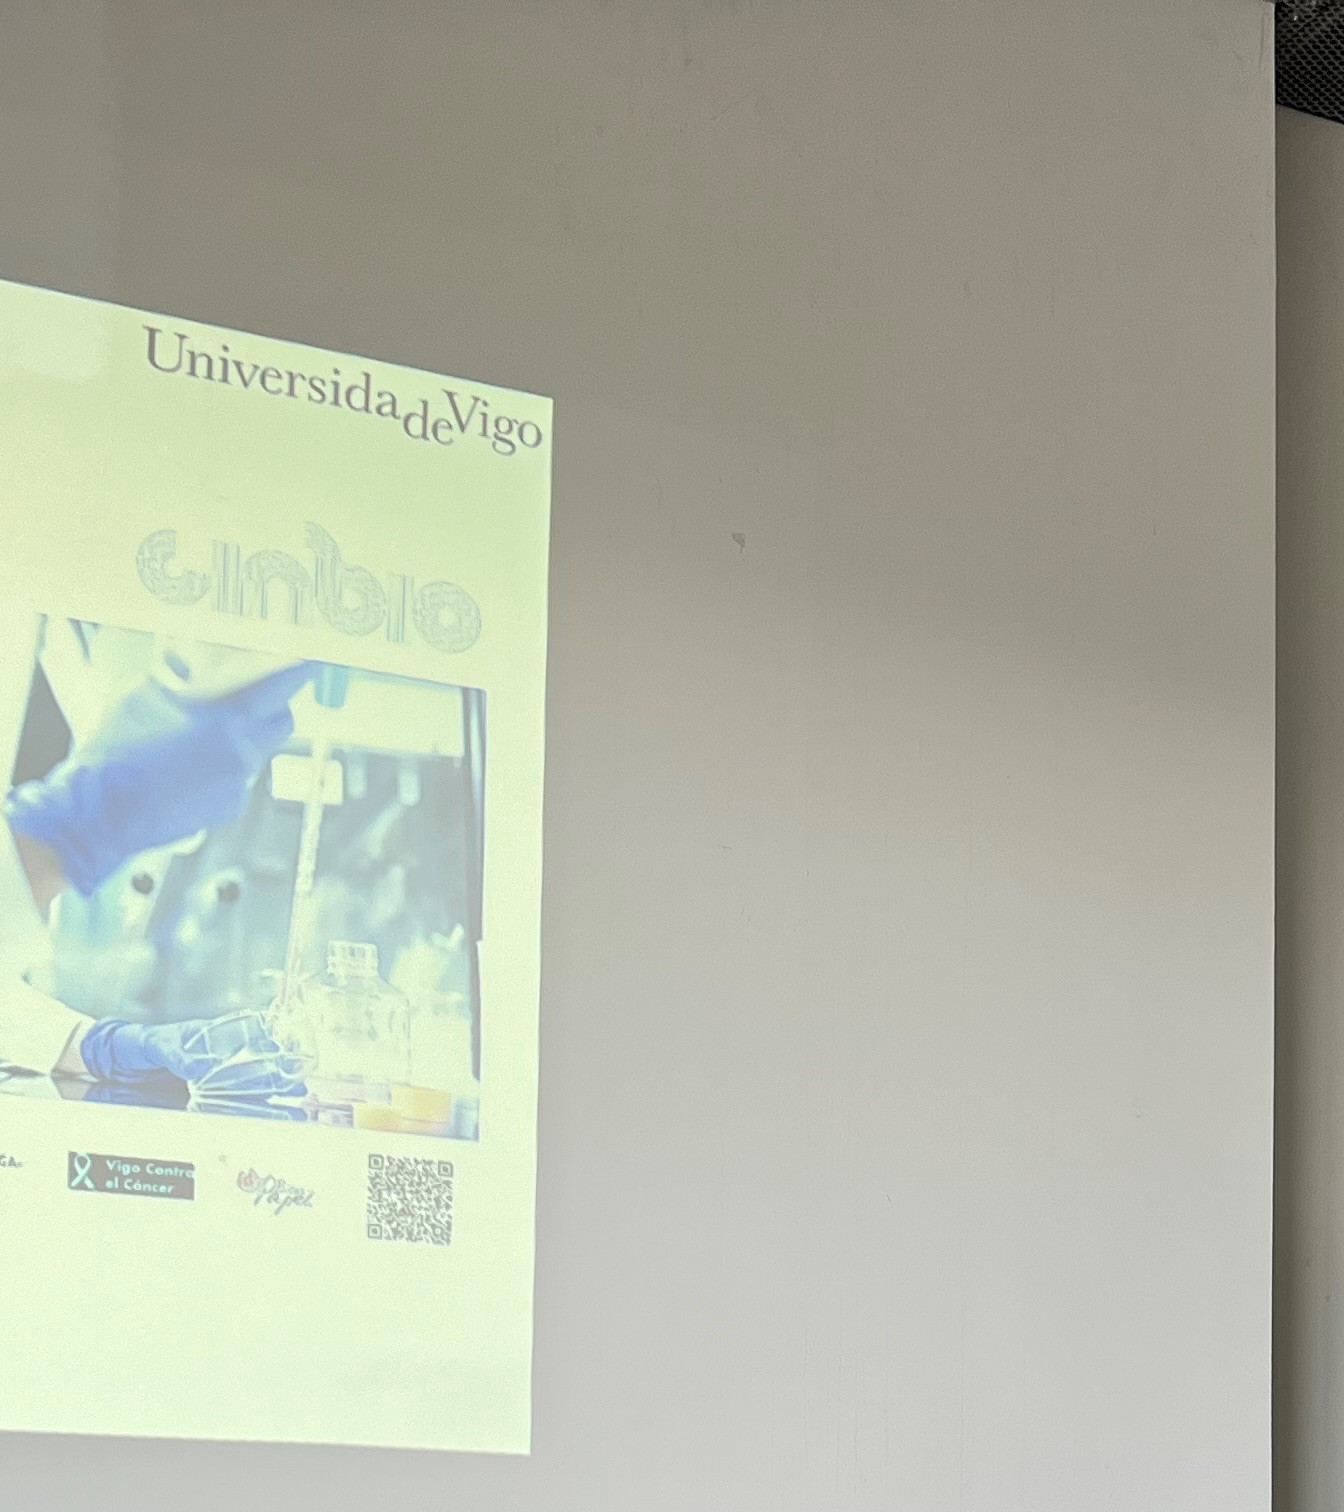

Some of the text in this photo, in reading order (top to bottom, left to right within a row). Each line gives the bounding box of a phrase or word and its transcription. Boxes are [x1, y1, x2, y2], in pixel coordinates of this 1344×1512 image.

[106, 1159, 195, 1179] Vigo Contra
[106, 1176, 176, 1195] el Cáncer
